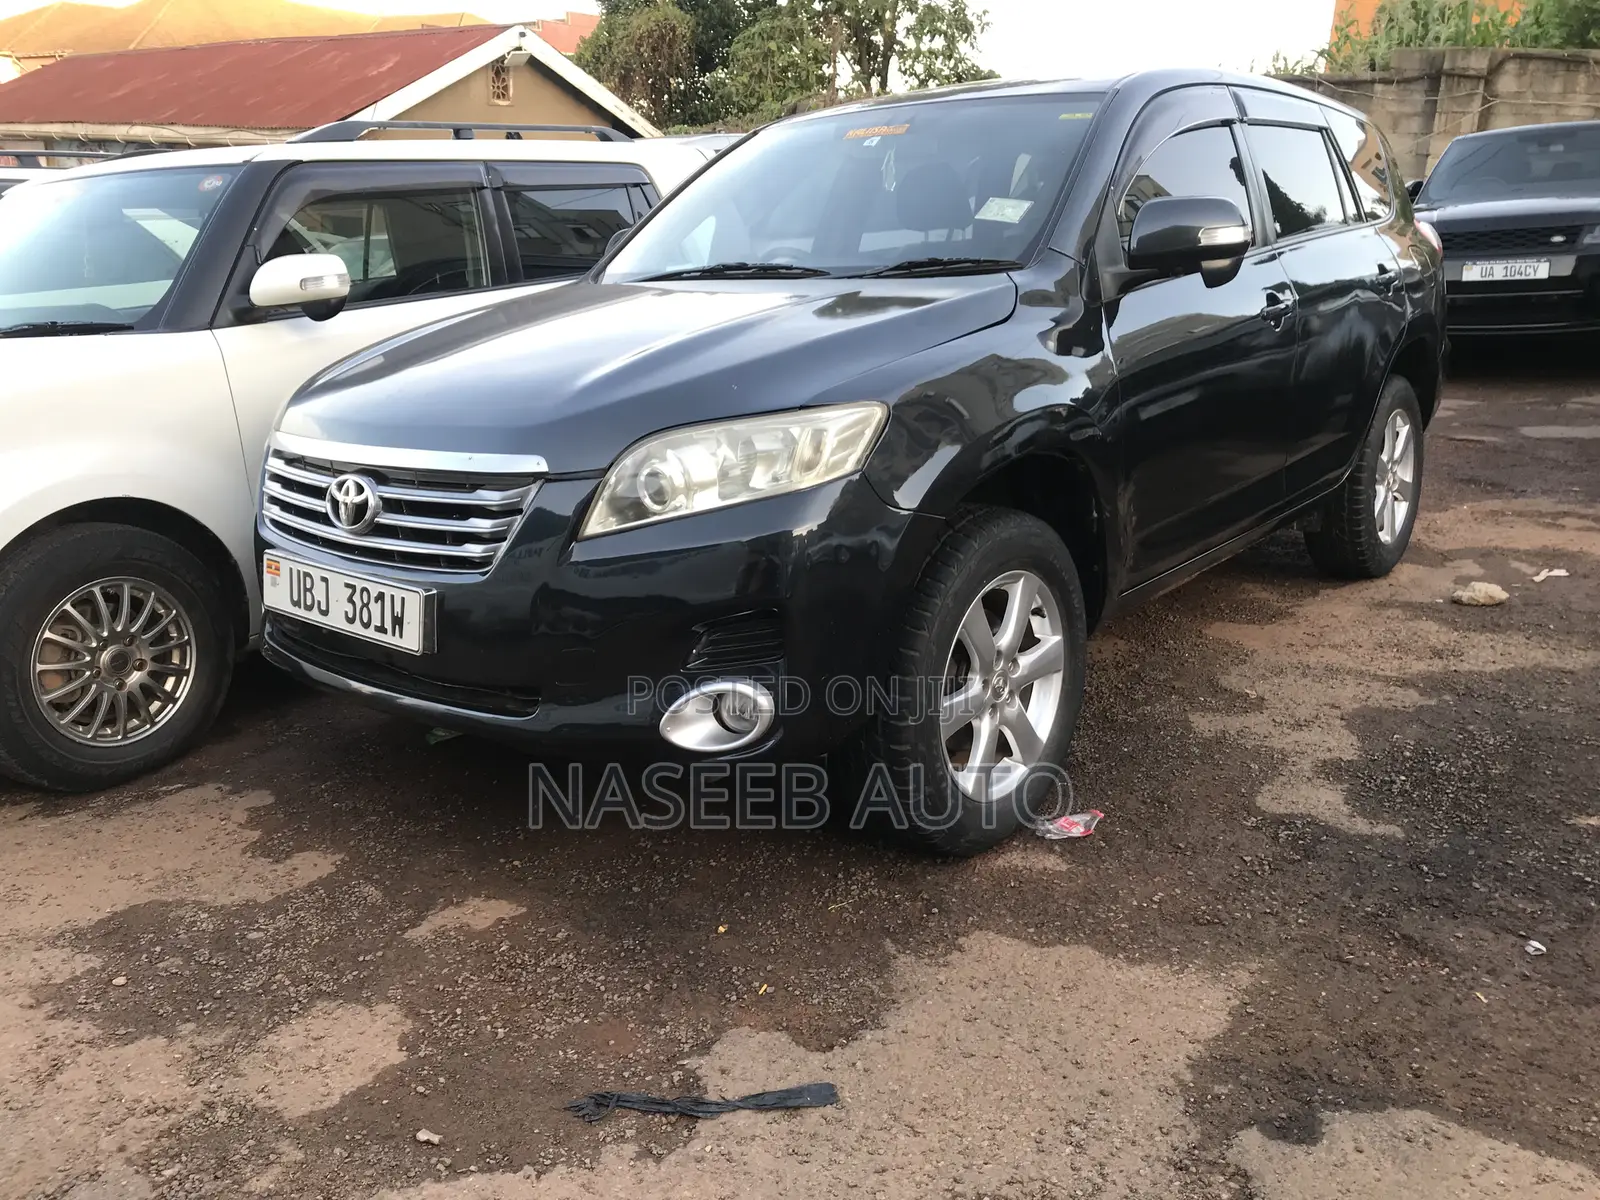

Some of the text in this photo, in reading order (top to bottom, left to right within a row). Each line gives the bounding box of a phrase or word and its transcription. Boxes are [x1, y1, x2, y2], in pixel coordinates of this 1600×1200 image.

[1480, 264, 1541, 279] UA 104CY
[289, 566, 405, 639] UBJ 381W
